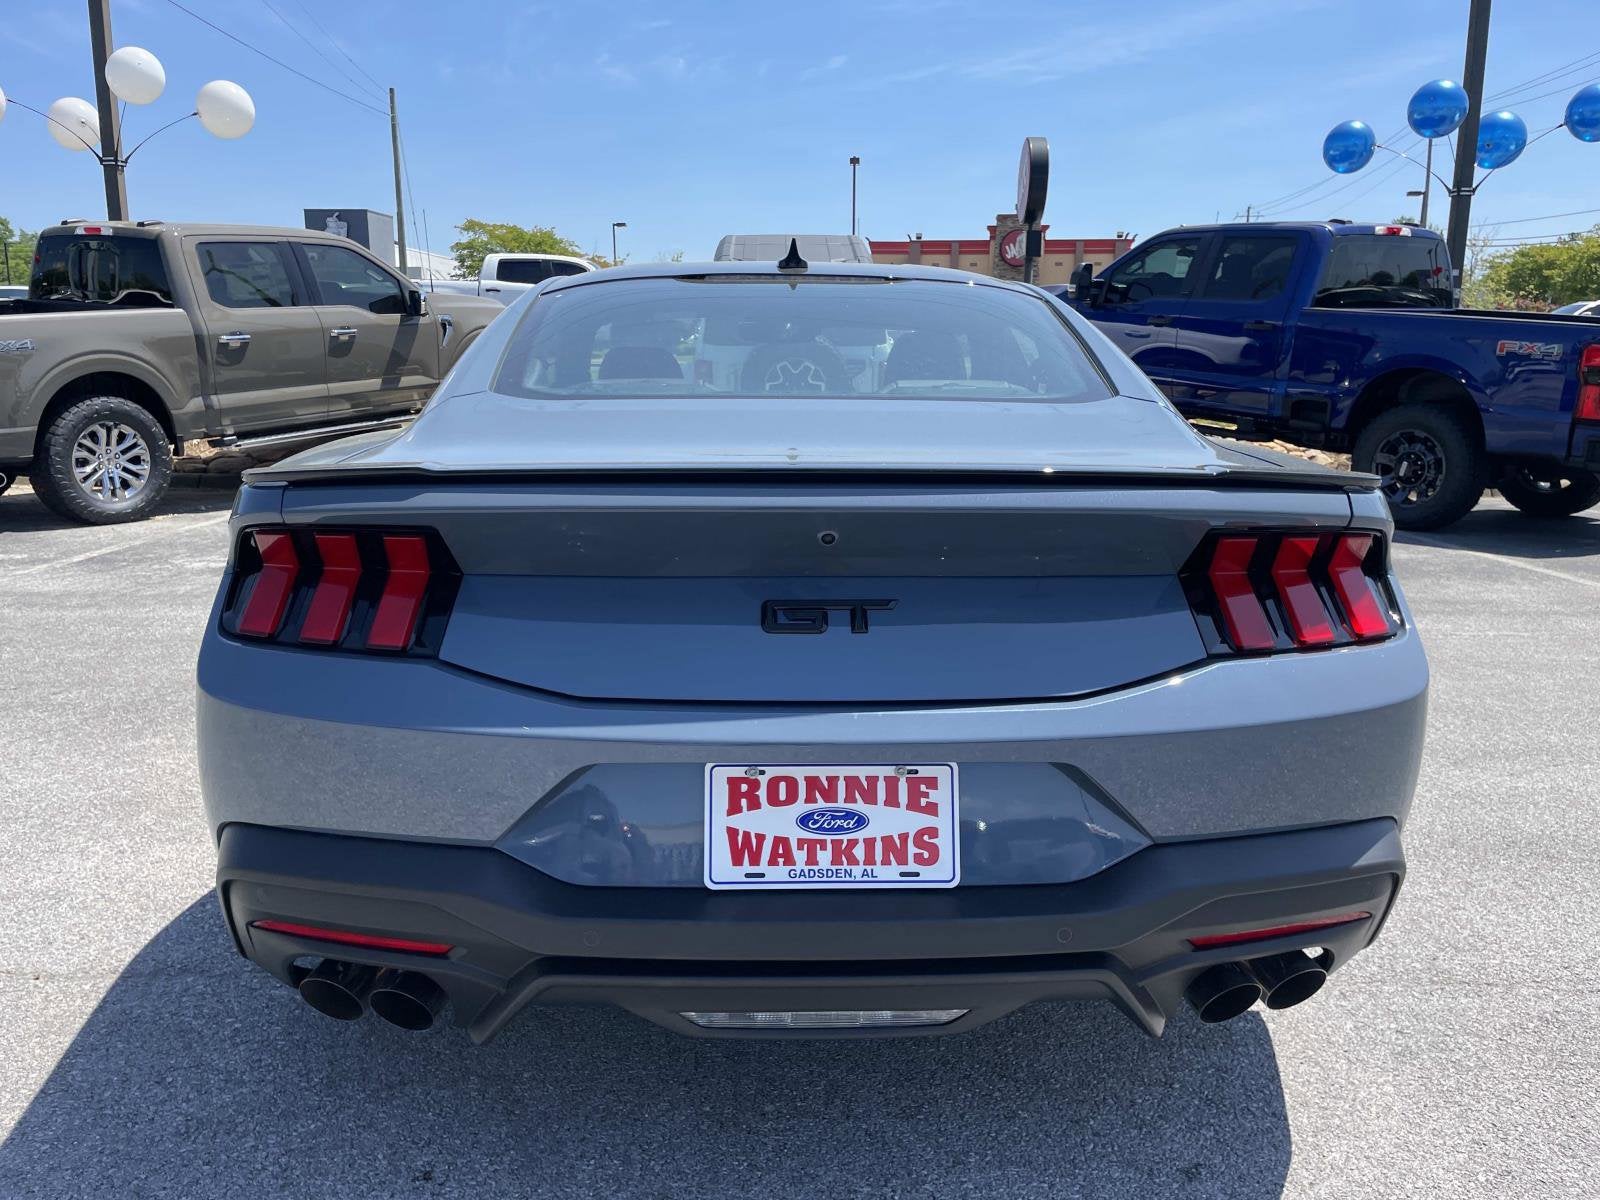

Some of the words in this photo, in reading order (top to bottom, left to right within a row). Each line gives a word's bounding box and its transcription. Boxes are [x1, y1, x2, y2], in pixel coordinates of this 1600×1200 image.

[1496, 340, 1563, 360] FX4
[761, 599, 899, 634] GT
[726, 775, 939, 818] RONNIE
[808, 811, 858, 829] Ford
[726, 826, 941, 867] WATKINS
[788, 868, 857, 880] GADSDEN,
[861, 868, 878, 879] AL
